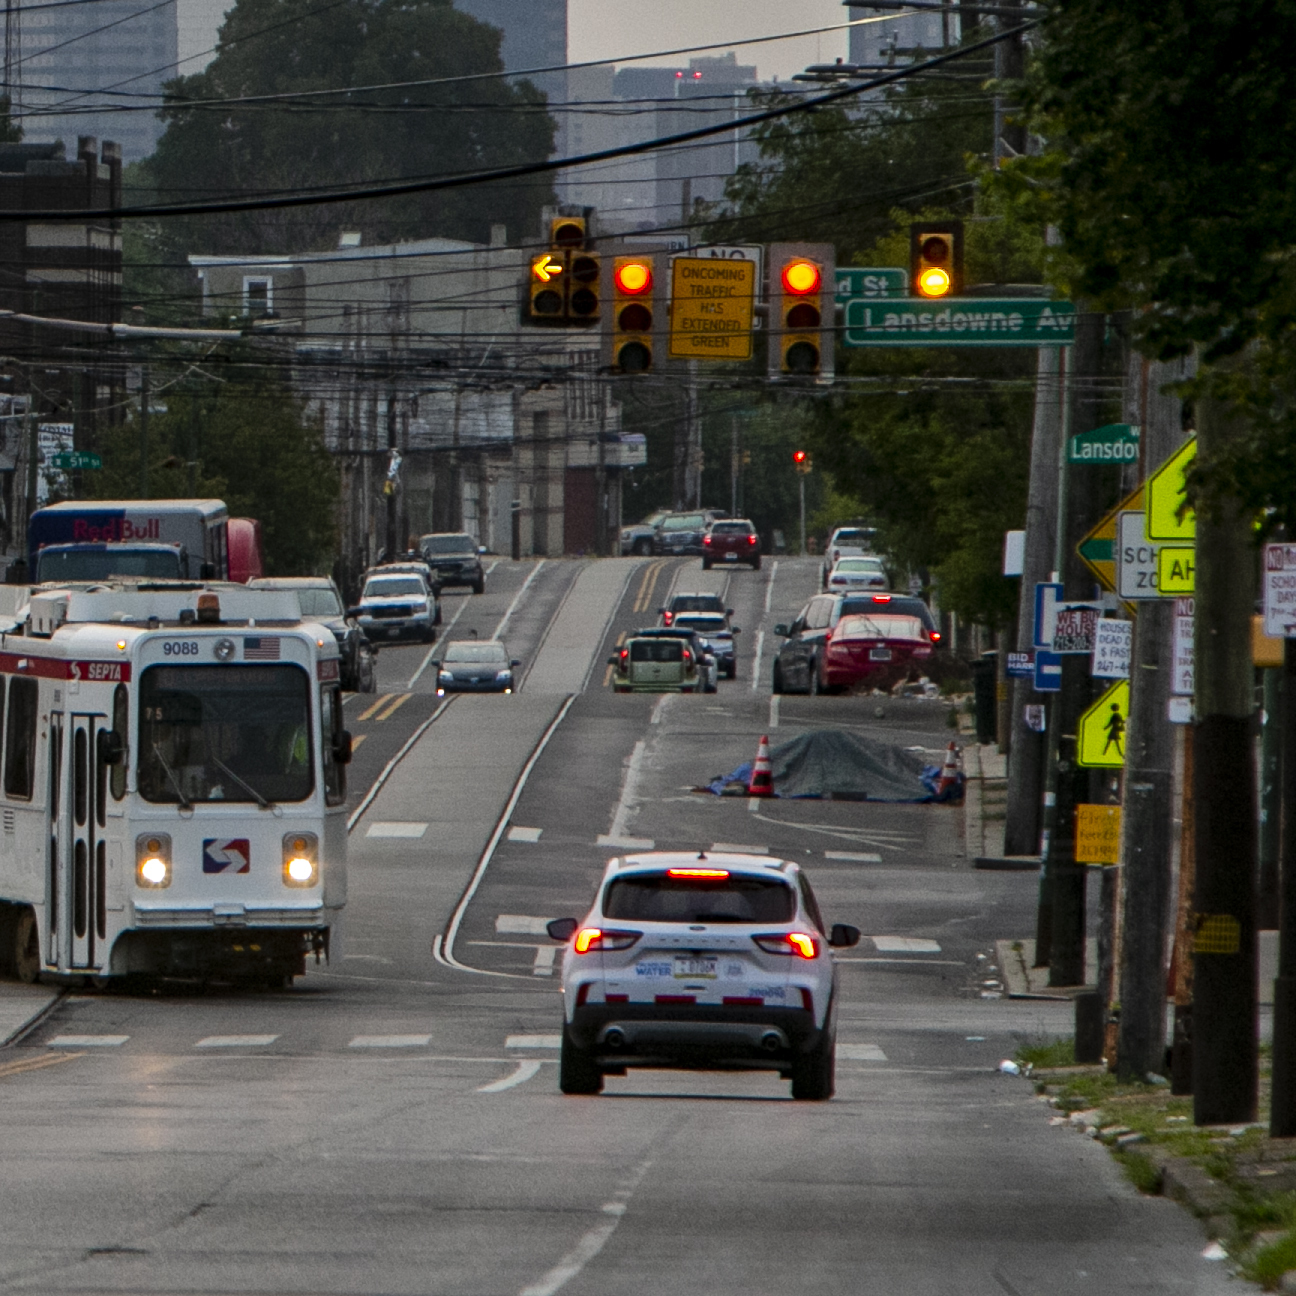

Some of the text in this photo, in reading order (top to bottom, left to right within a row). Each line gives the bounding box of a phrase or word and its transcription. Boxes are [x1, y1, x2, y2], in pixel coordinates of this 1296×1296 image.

[682, 267, 745, 281] ONCOMING
[690, 284, 735, 297] TRAFFIC
[863, 276, 890, 297] St
[701, 303, 723, 314] HAS
[682, 318, 741, 332] EXTENDED
[864, 306, 1074, 333] Lansdowne Av
[692, 335, 729, 347] GREEN
[1071, 437, 1141, 459] Lansdo
[73, 519, 160, 539] Red Bull
[1124, 546, 1159, 564] SCH
[1136, 571, 1159, 589] ZO
[1176, 597, 1195, 616] NO
[1058, 611, 1077, 623] WE
[1056, 623, 1096, 636] HOUSE
[163, 642, 199, 655] 9088
[1008, 653, 1028, 662] BID
[88, 663, 121, 680] SEPTA
[636, 967, 672, 977] WATER
